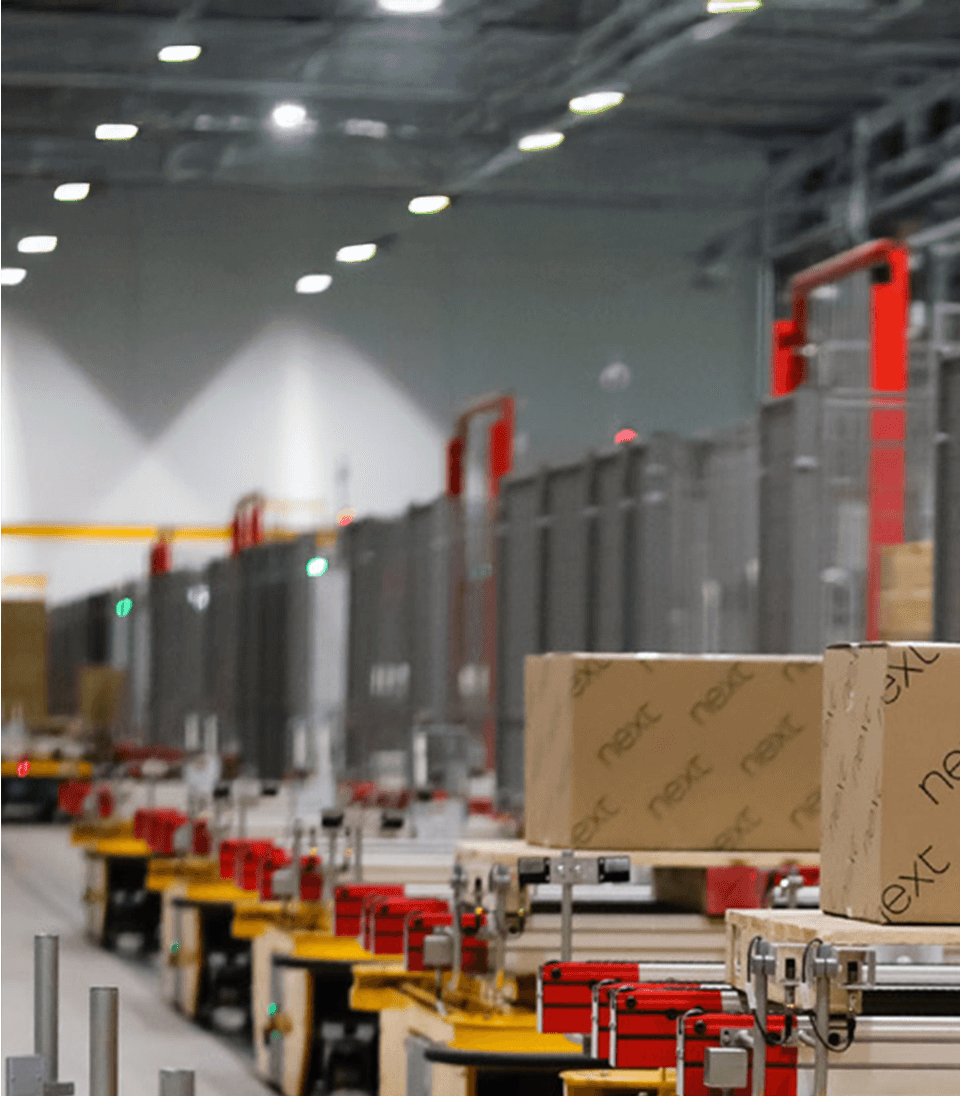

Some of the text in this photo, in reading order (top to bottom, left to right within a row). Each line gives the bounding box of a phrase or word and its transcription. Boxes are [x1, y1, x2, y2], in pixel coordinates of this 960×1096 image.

[596, 701, 664, 769] next
[740, 710, 806, 778] next
[646, 754, 714, 821] next
